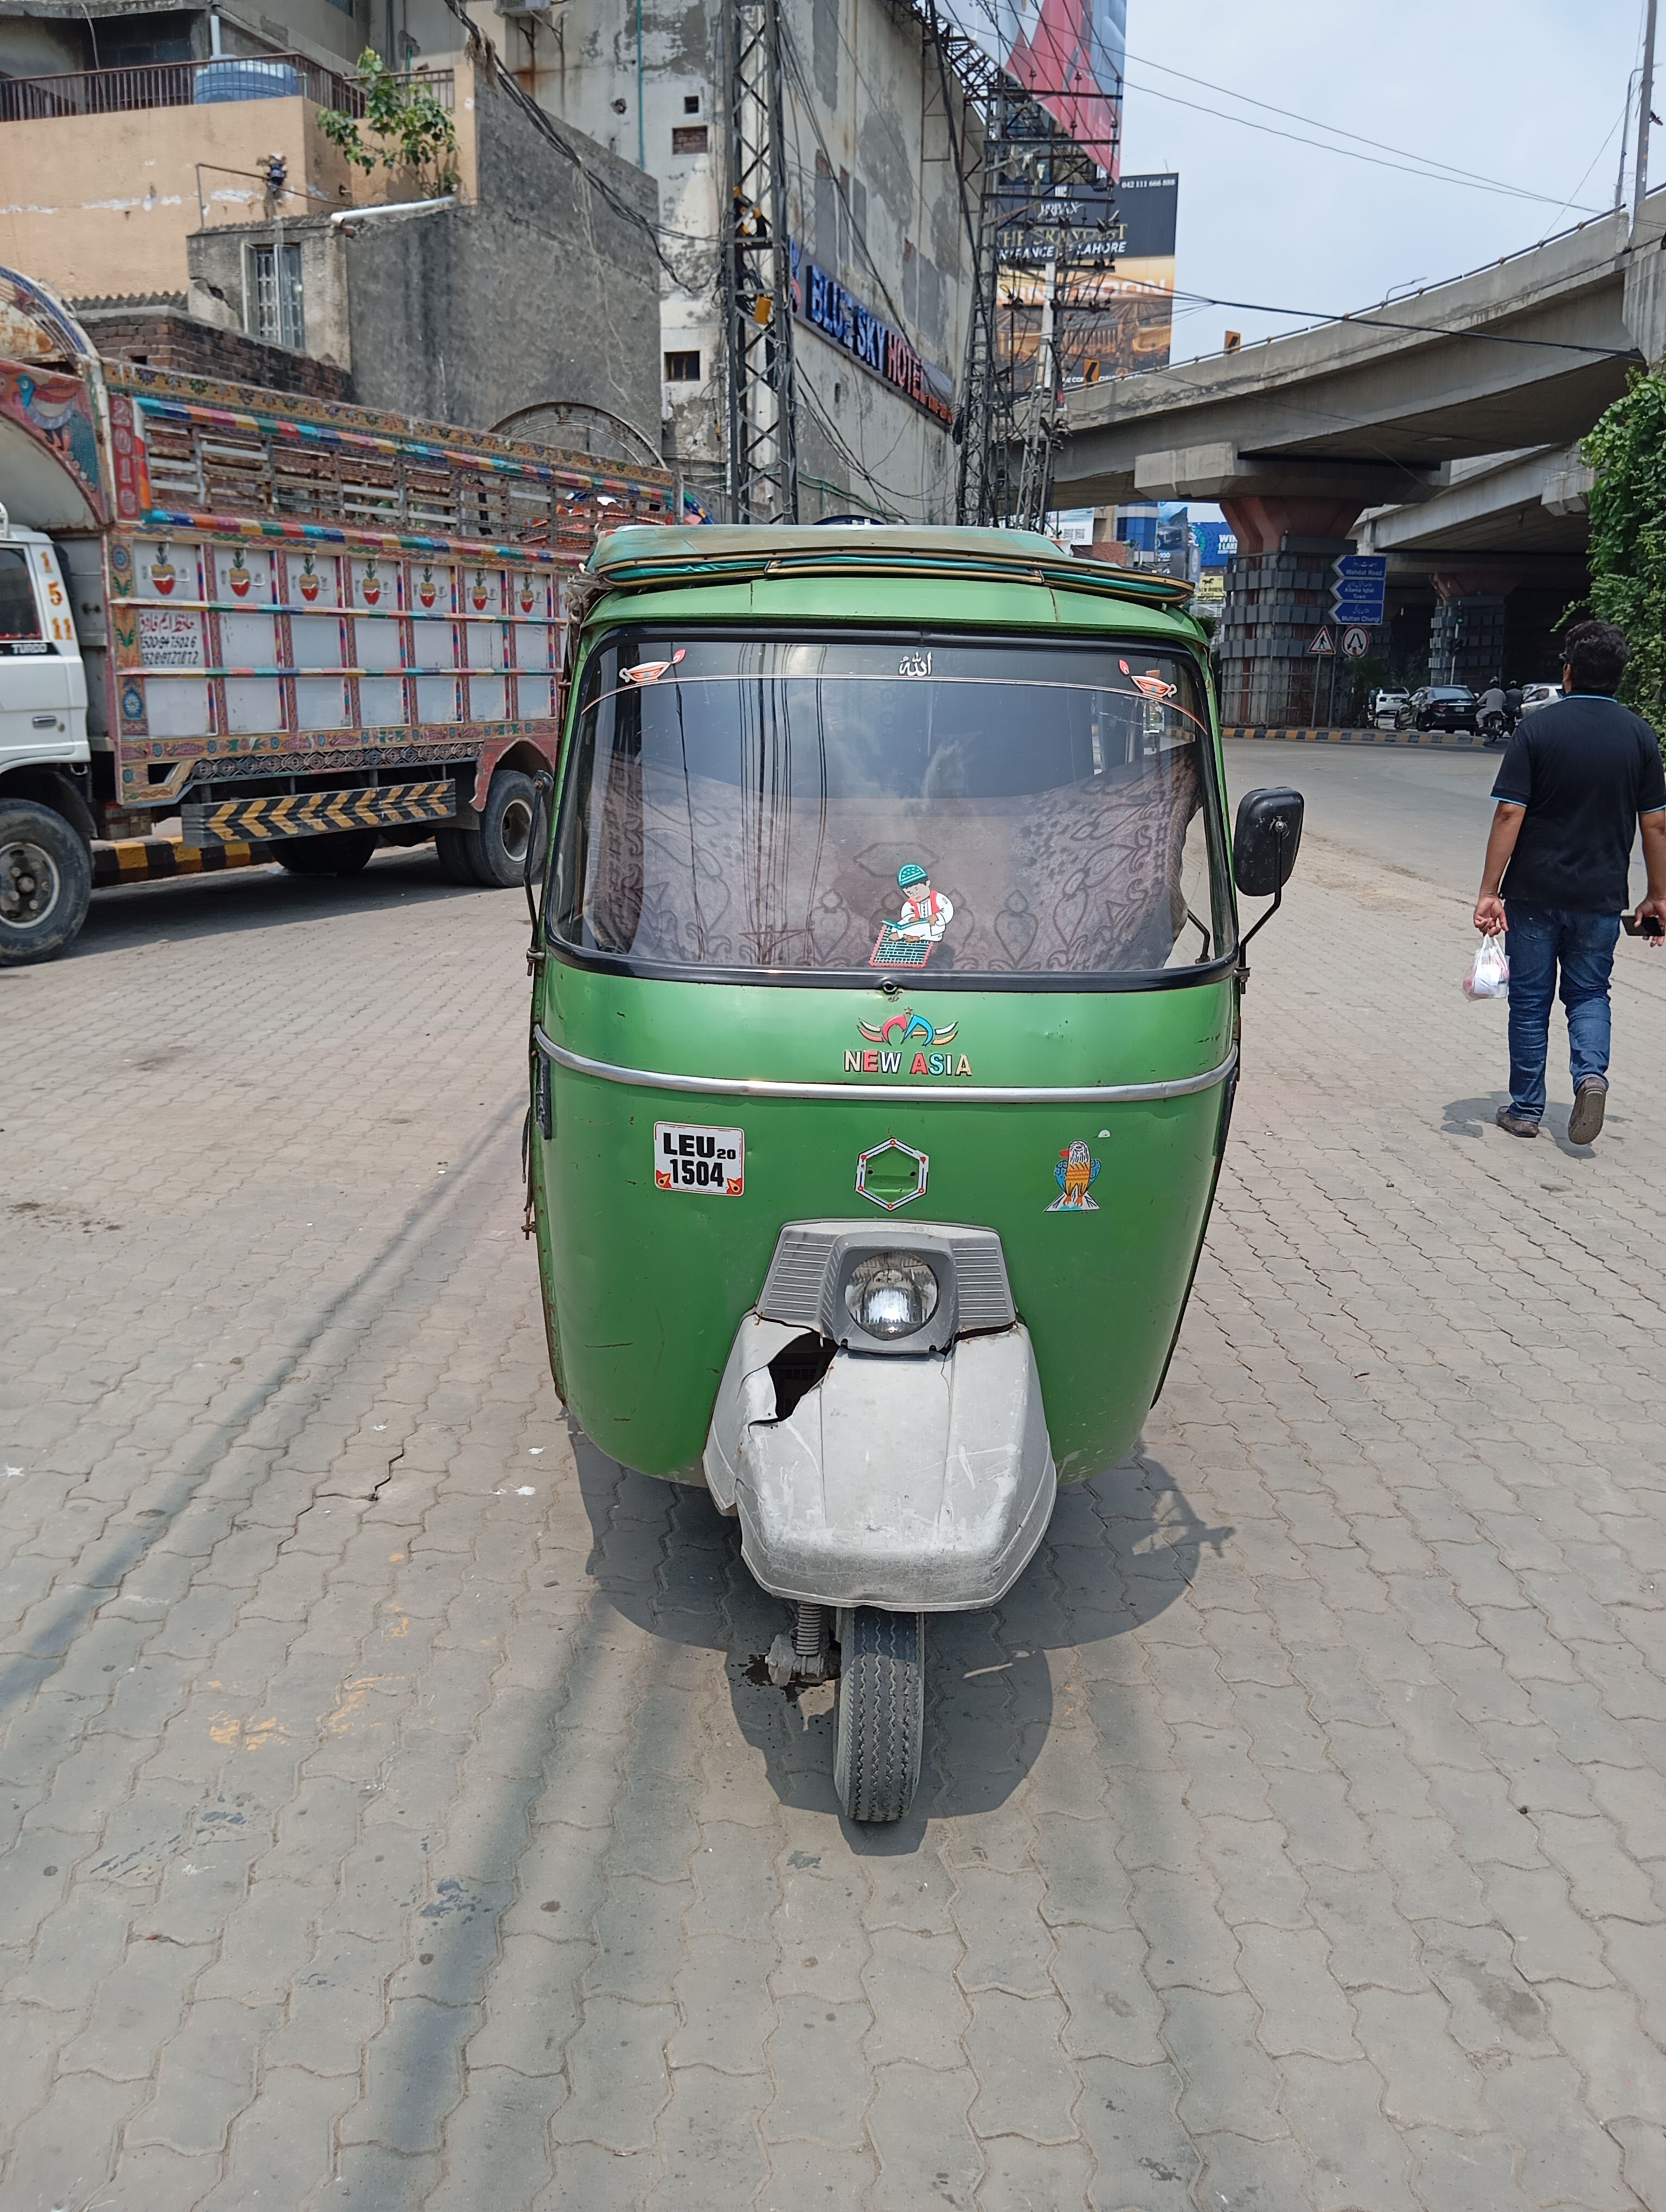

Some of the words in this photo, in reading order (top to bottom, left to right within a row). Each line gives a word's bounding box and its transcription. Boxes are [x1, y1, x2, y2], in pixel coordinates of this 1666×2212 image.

[855, 305, 887, 371] SKY
[885, 330, 927, 406] HOTEL
[844, 1050, 902, 1073] NEW
[909, 1052, 972, 1076] ASIA
[663, 1133, 715, 1158] LEU
[716, 1148, 736, 1159] 20
[670, 1159, 724, 1187] 1504
